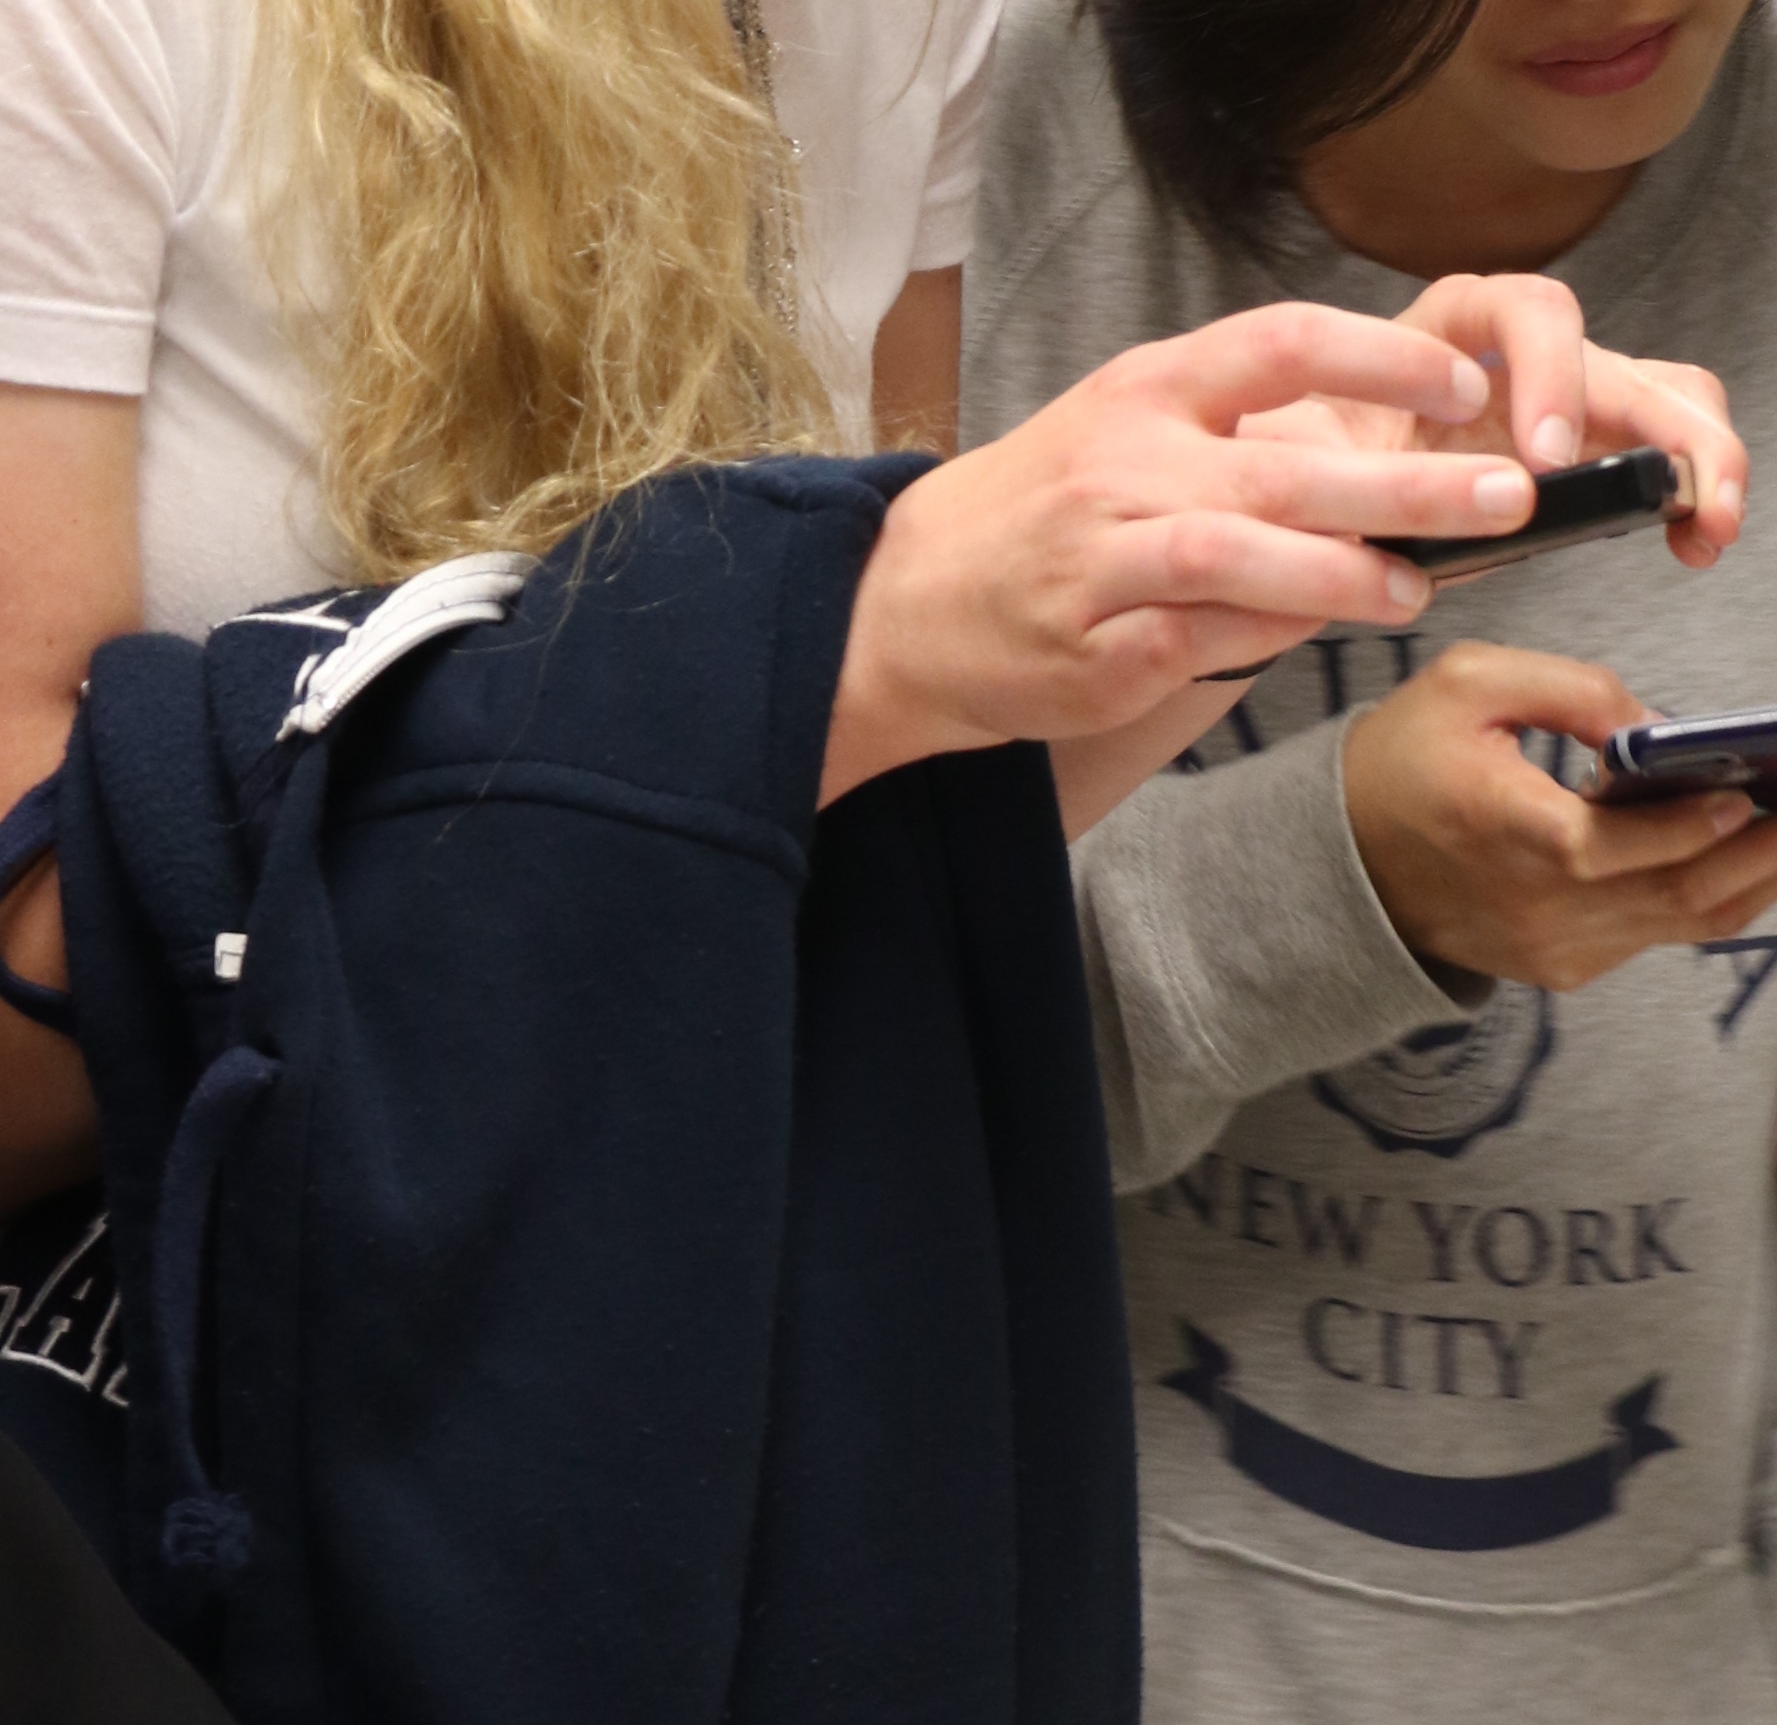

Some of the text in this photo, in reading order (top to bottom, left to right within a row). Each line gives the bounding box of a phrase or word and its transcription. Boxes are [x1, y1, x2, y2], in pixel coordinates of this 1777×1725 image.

[1146, 1150, 1696, 1288] NEW YORK
[1303, 1296, 1545, 1400] CITY
